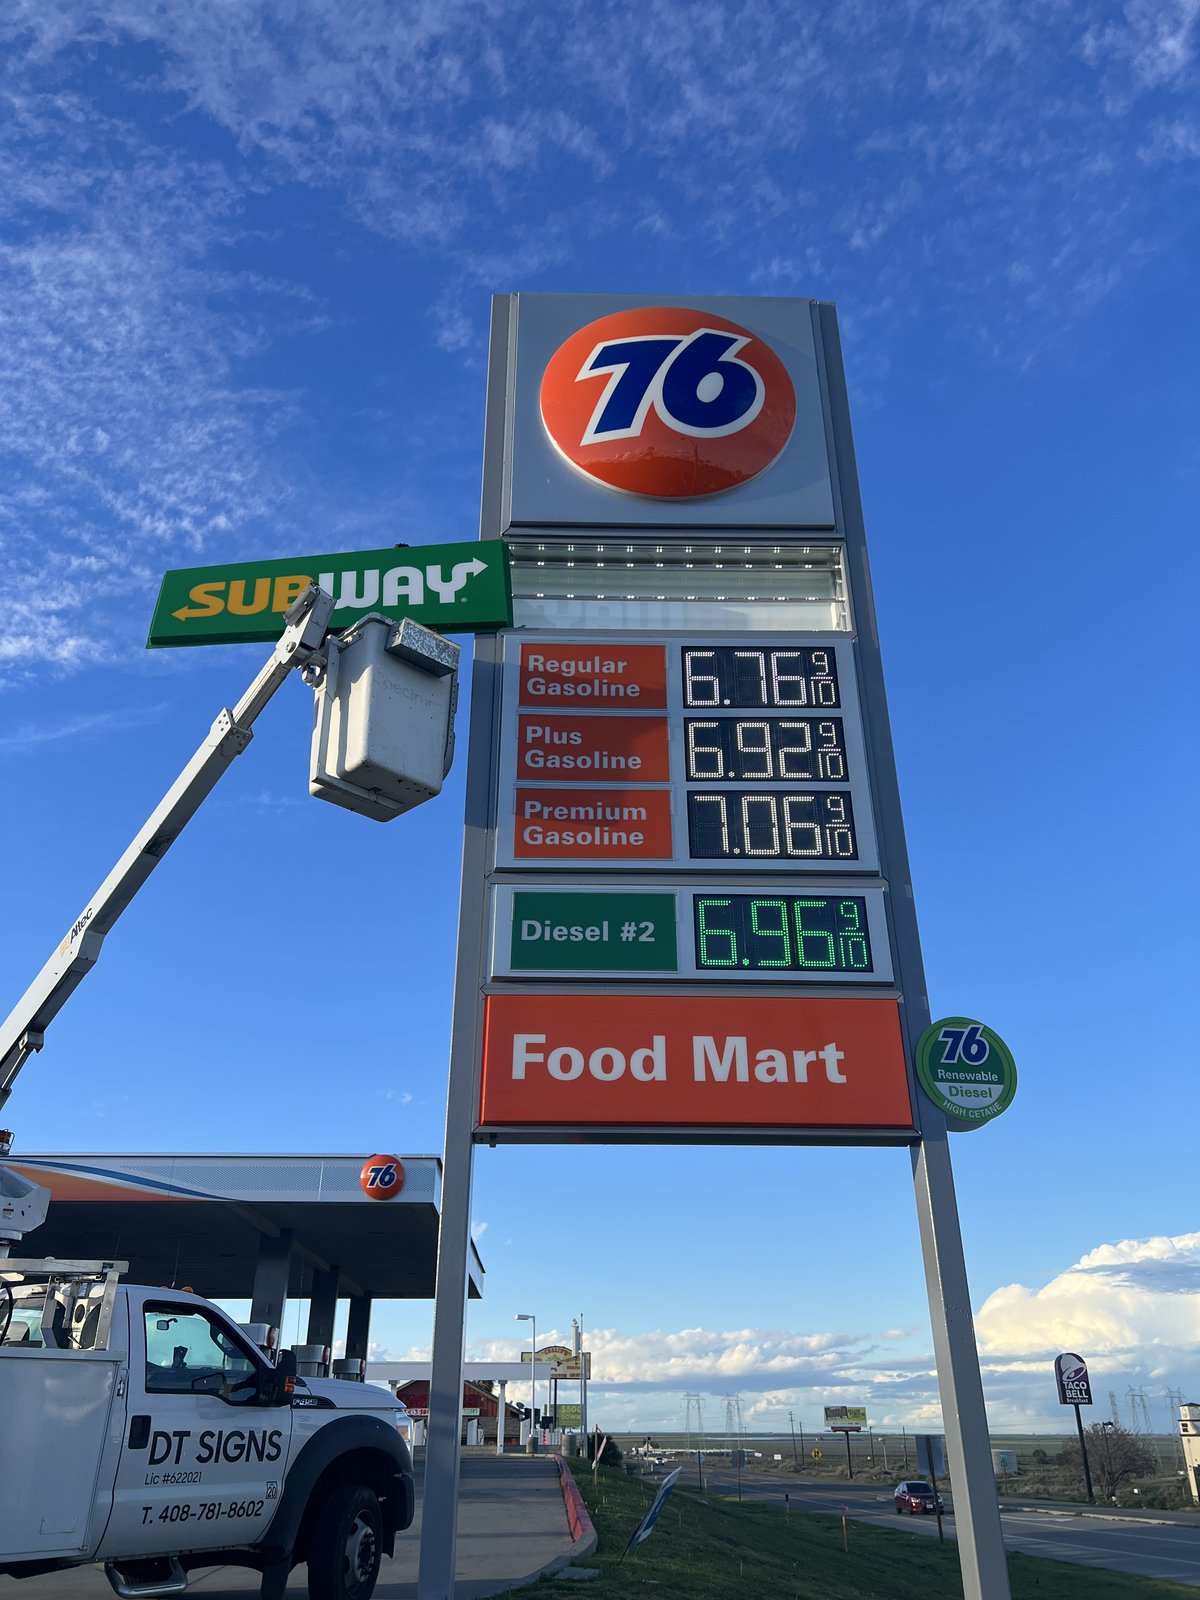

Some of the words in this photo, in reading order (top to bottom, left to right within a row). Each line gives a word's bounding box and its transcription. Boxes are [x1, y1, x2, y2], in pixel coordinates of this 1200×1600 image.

[574, 327, 766, 447] 76
[170, 557, 489, 622] SUBWAY
[527, 655, 628, 676] Regular
[526, 677, 641, 697] Gasoline
[685, 651, 807, 706] 6.76
[525, 725, 583, 746] Plus
[524, 750, 643, 770] Gasoline
[688, 722, 812, 779] 6.92
[523, 800, 648, 821] Premium
[522, 826, 645, 846] Gasoline
[694, 796, 823, 856] 7.06
[520, 919, 609, 942] Diesel
[620, 920, 656, 942] #2
[699, 900, 836, 967] 6.96
[937, 1024, 990, 1066] 76
[511, 1033, 667, 1082] Food
[692, 1034, 847, 1085] Mart
[937, 1069, 998, 1082] Renewable
[948, 1085, 993, 1099] Diesel
[943, 1099, 966, 1117] HIGH
[968, 1101, 1003, 1118] CETANE
[366, 1163, 397, 1188] 76
[1062, 1381, 1087, 1390] TACO
[1065, 1389, 1089, 1398] BELL
[148, 1430, 191, 1465] DT
[195, 1430, 283, 1464] SIGNS
[144, 1472, 159, 1485] Lic
[162, 1471, 202, 1484] #622021
[267, 1486, 277, 1498] 20
[142, 1506, 153, 1525] T.
[158, 1500, 264, 1523] 408-781-8602
